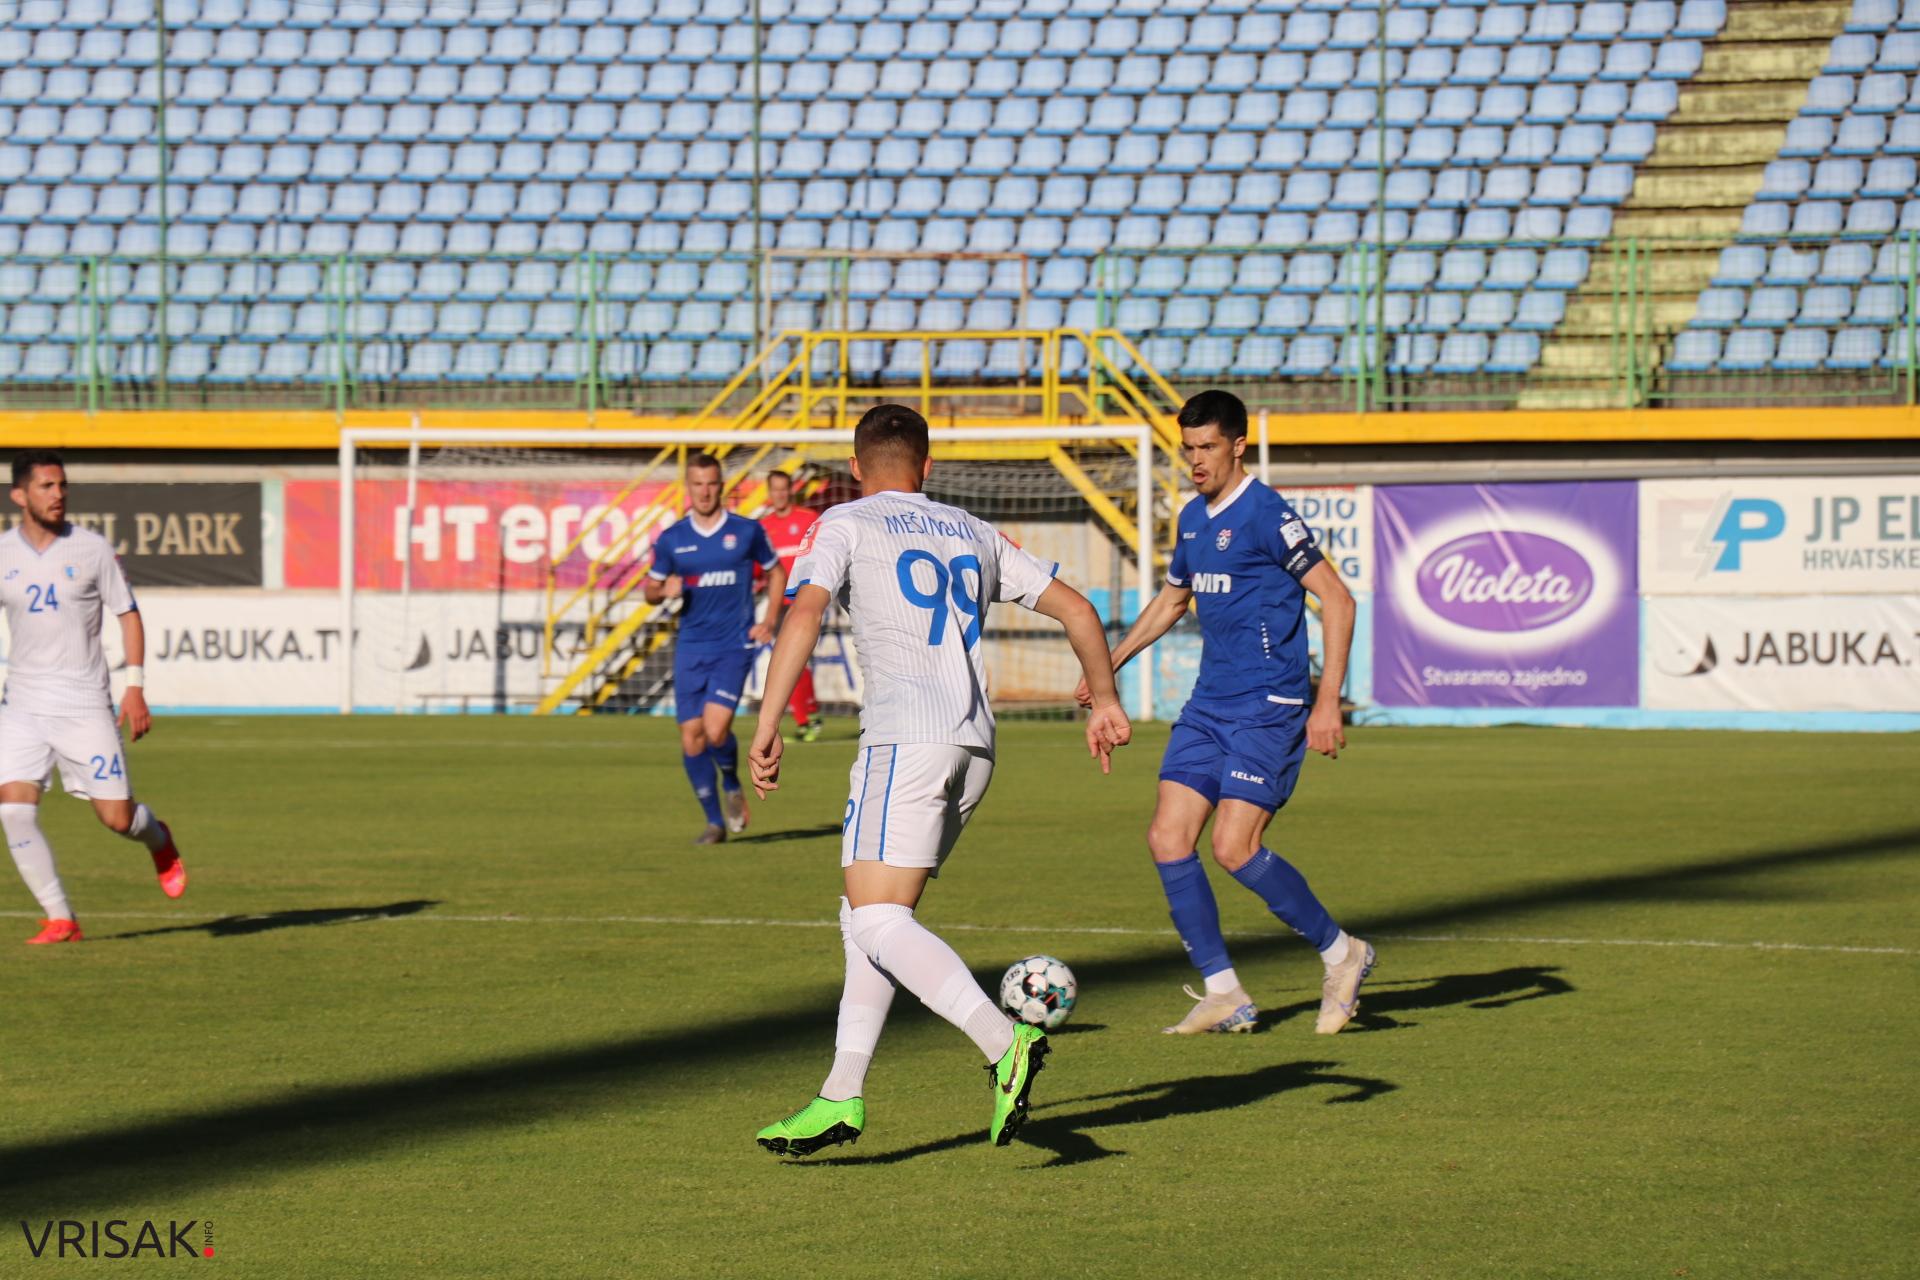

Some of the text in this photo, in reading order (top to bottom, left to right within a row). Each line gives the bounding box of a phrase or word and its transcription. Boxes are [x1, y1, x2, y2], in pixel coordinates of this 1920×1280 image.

[135, 513, 243, 555] PARK
[884, 511, 982, 543] MEŠINOVI
[1805, 496, 1860, 543] JP
[1803, 548, 1920, 571] HRVATSKE
[1434, 553, 1575, 604] Violeta
[26, 583, 59, 613] 24
[896, 549, 982, 650] 99
[1422, 665, 1588, 690] Stvaramo zajedno
[89, 752, 122, 780] 24
[1230, 770, 1265, 784] KELME
